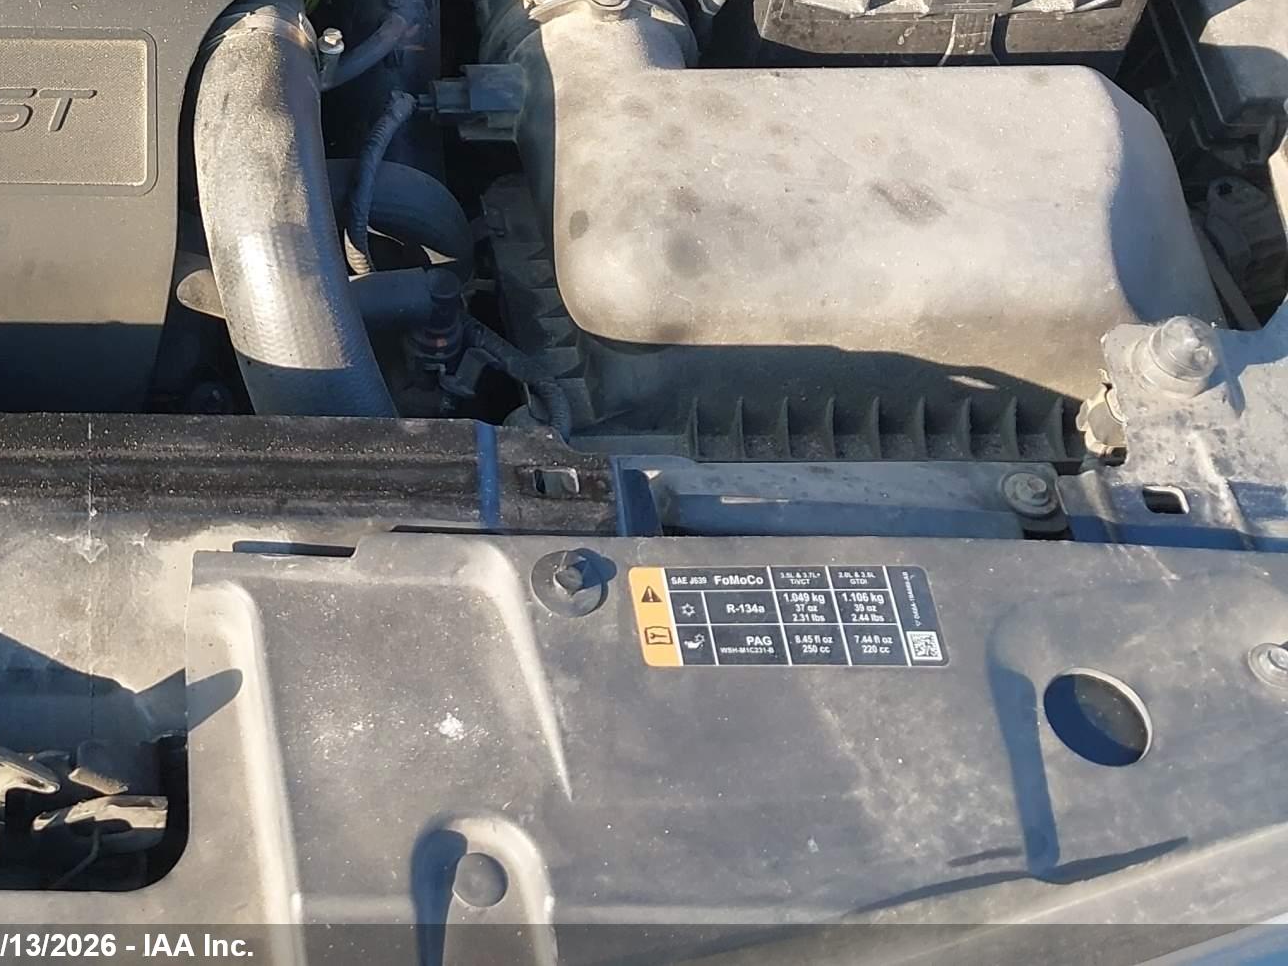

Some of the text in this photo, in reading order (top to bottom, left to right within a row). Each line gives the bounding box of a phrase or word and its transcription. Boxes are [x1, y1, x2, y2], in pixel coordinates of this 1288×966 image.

[671, 576, 708, 585] SAE J639
[714, 575, 764, 585] FoMoCo
[783, 593, 825, 604] 1.049 kg
[842, 593, 884, 604] 1.106 kg
[726, 604, 765, 613] R-134a
[795, 604, 804, 612] 37
[792, 614, 825, 622] 2.31 lbs
[851, 614, 885, 622] 2.44 lbs
[746, 636, 773, 646] PAG
[802, 645, 818, 653] 250
[862, 645, 878, 653] 220
